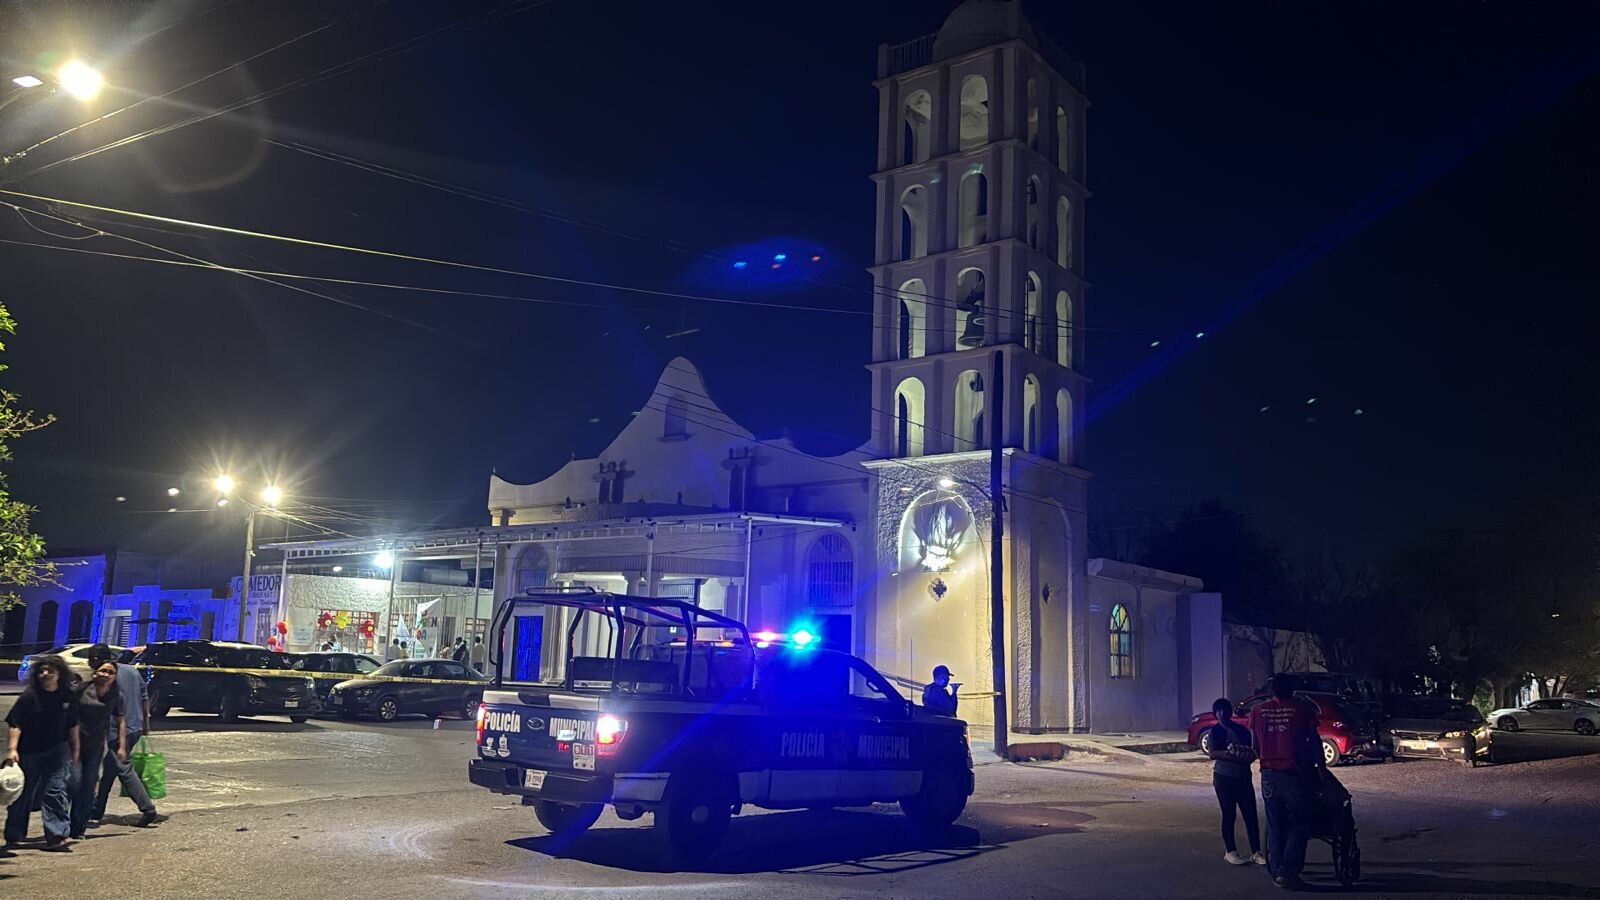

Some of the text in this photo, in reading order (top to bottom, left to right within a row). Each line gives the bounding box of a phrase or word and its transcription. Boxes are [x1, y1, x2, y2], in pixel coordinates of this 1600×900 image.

[236, 575, 282, 592] CMEDOR
[484, 710, 595, 741] POLICÍA MUNICIPAL
[857, 734, 910, 759] MUNICIPAL
